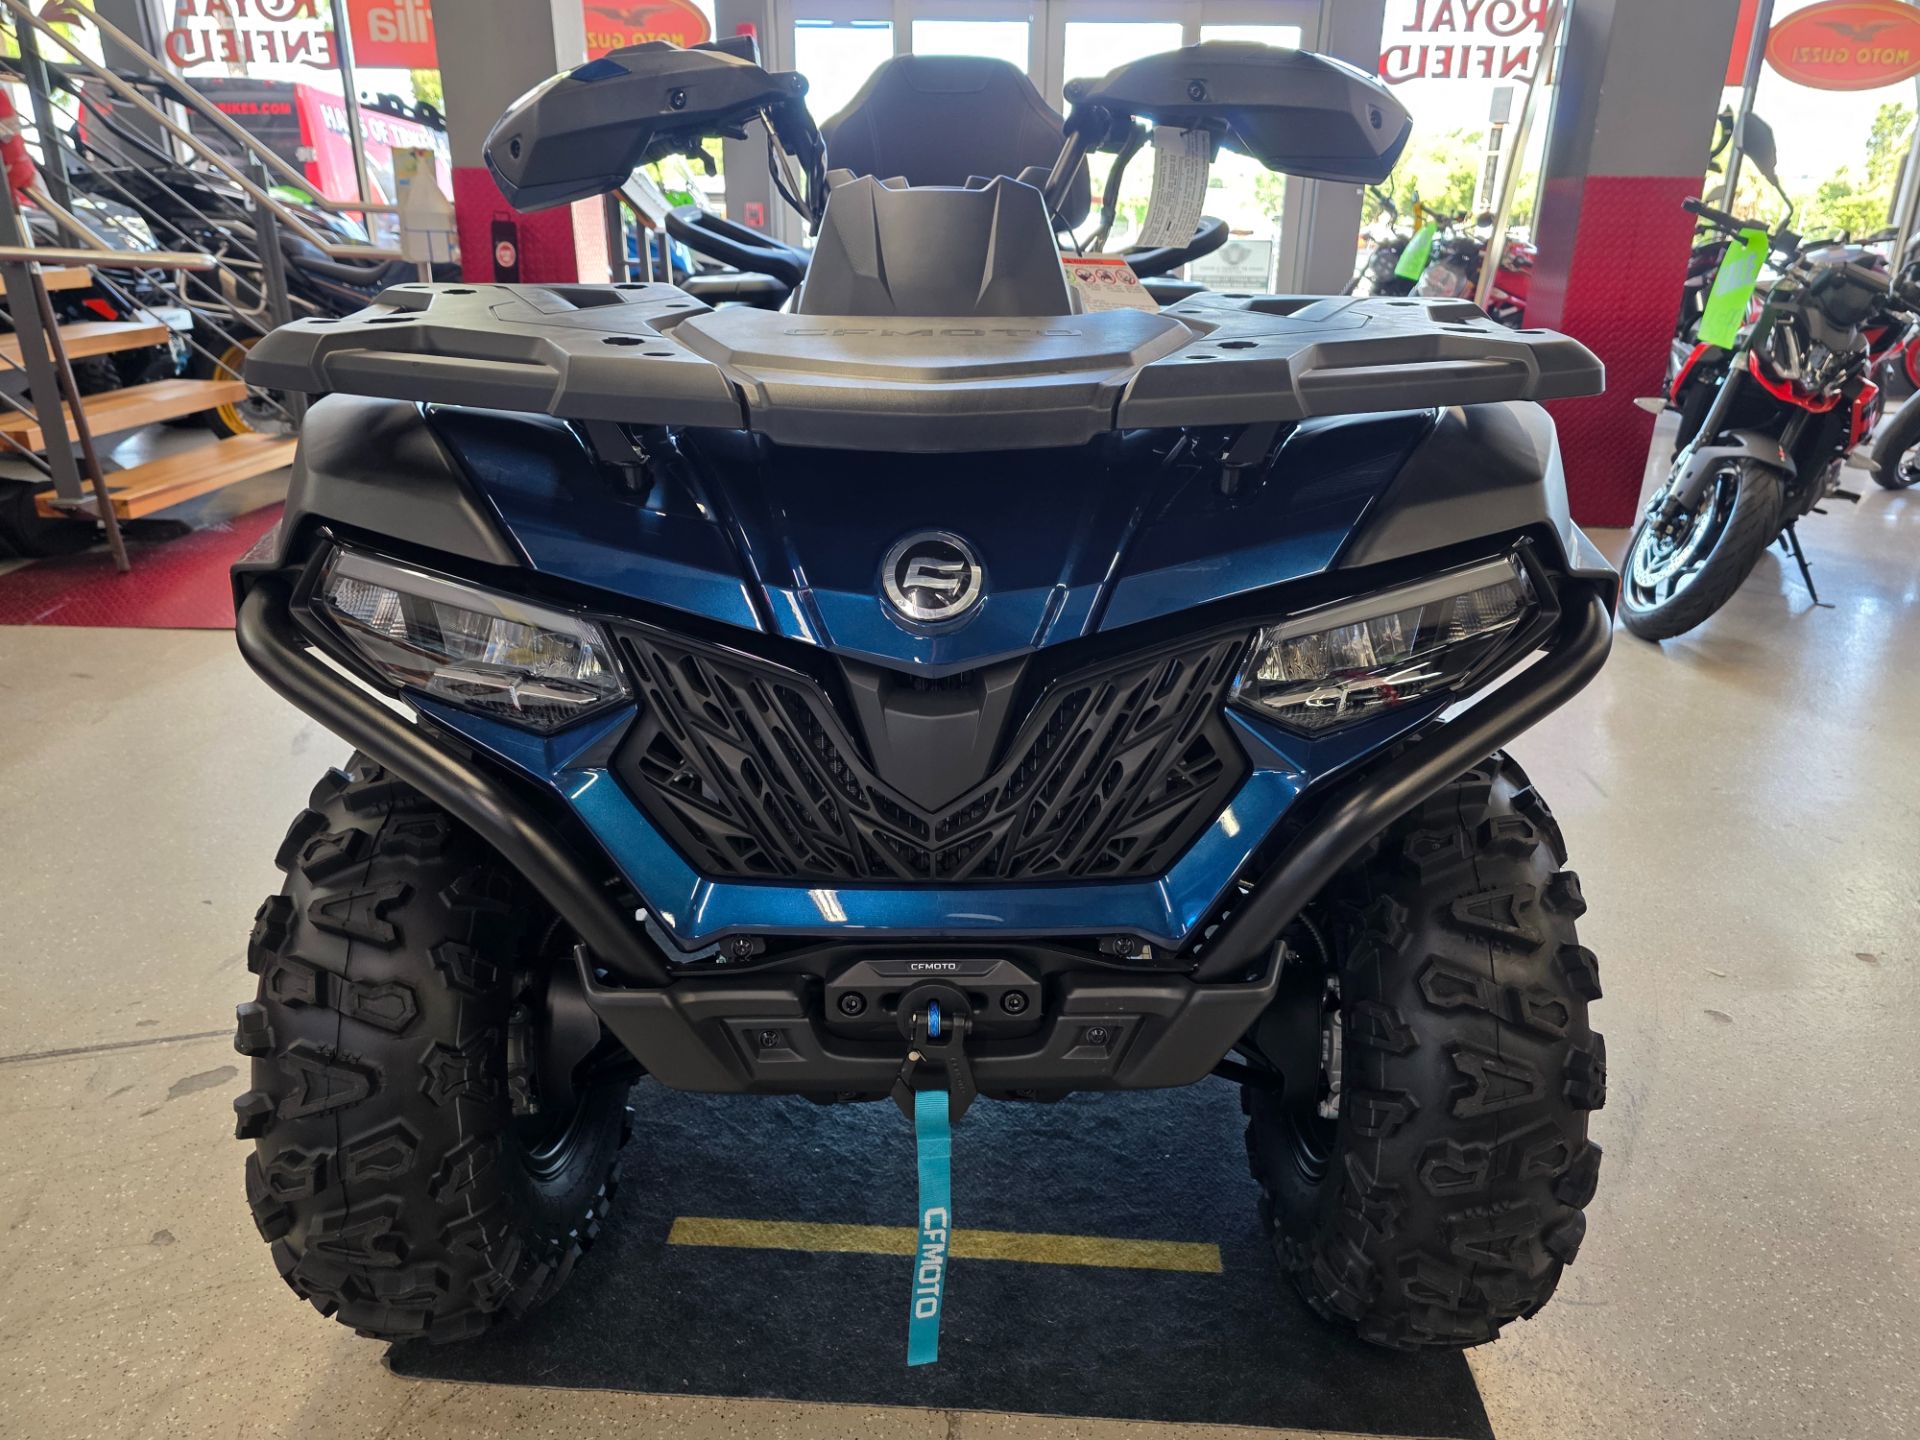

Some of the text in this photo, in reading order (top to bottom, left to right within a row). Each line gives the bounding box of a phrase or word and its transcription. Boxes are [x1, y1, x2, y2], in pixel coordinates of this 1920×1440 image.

[783, 328, 1083, 337] CFMOTO
[910, 962, 956, 971] CFMOTO
[915, 1206, 948, 1320] CFMOTO
